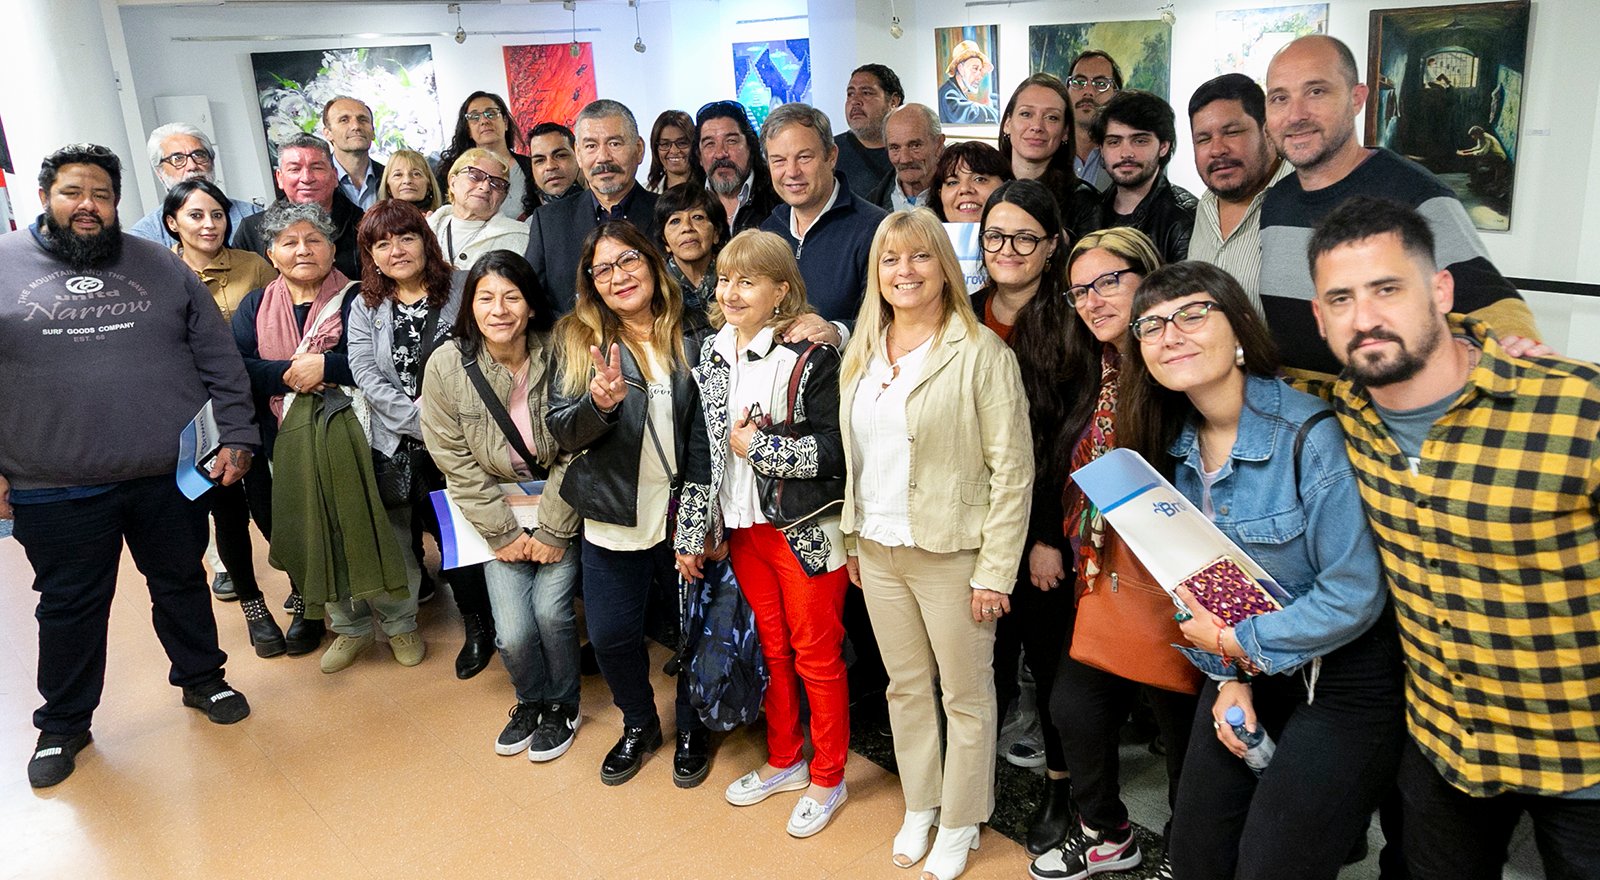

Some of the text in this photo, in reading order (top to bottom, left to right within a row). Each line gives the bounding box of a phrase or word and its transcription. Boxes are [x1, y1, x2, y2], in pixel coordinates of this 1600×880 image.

[17, 268, 147, 305] THE MOUNTAIN AND THE WAVE
[23, 300, 151, 321] Narrow
[66, 327, 95, 335] GOODS
[98, 321, 135, 332] COMPANY
[210, 690, 236, 703] PUMA
[35, 746, 62, 760] PUMA
